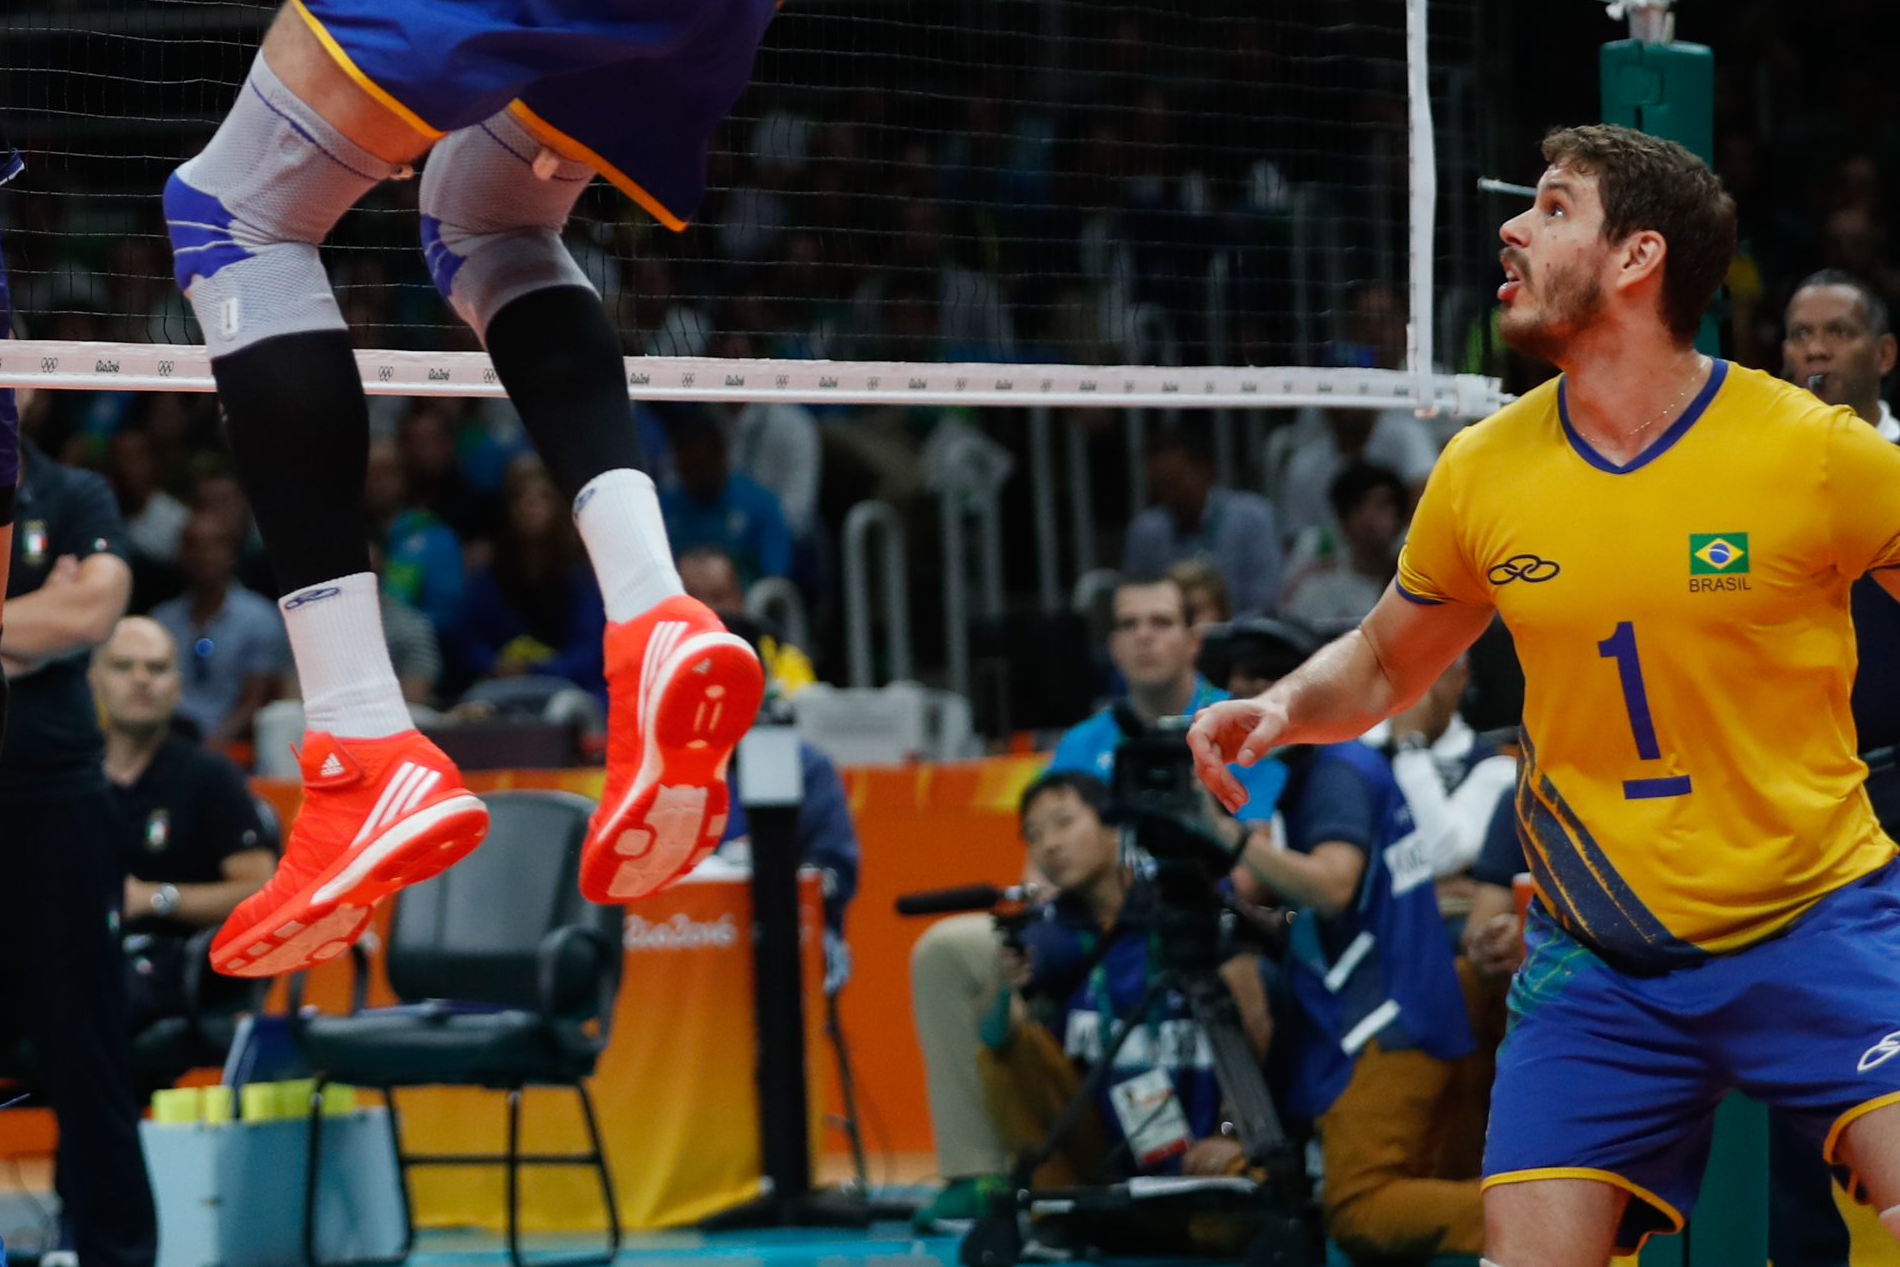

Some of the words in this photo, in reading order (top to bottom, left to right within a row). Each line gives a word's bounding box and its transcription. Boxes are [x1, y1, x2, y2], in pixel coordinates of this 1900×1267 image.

[95, 360, 120, 373] Rio2016
[428, 368, 450, 381] Rio2016
[1689, 577, 1752, 593] BRASIL
[1597, 620, 1662, 760] 1
